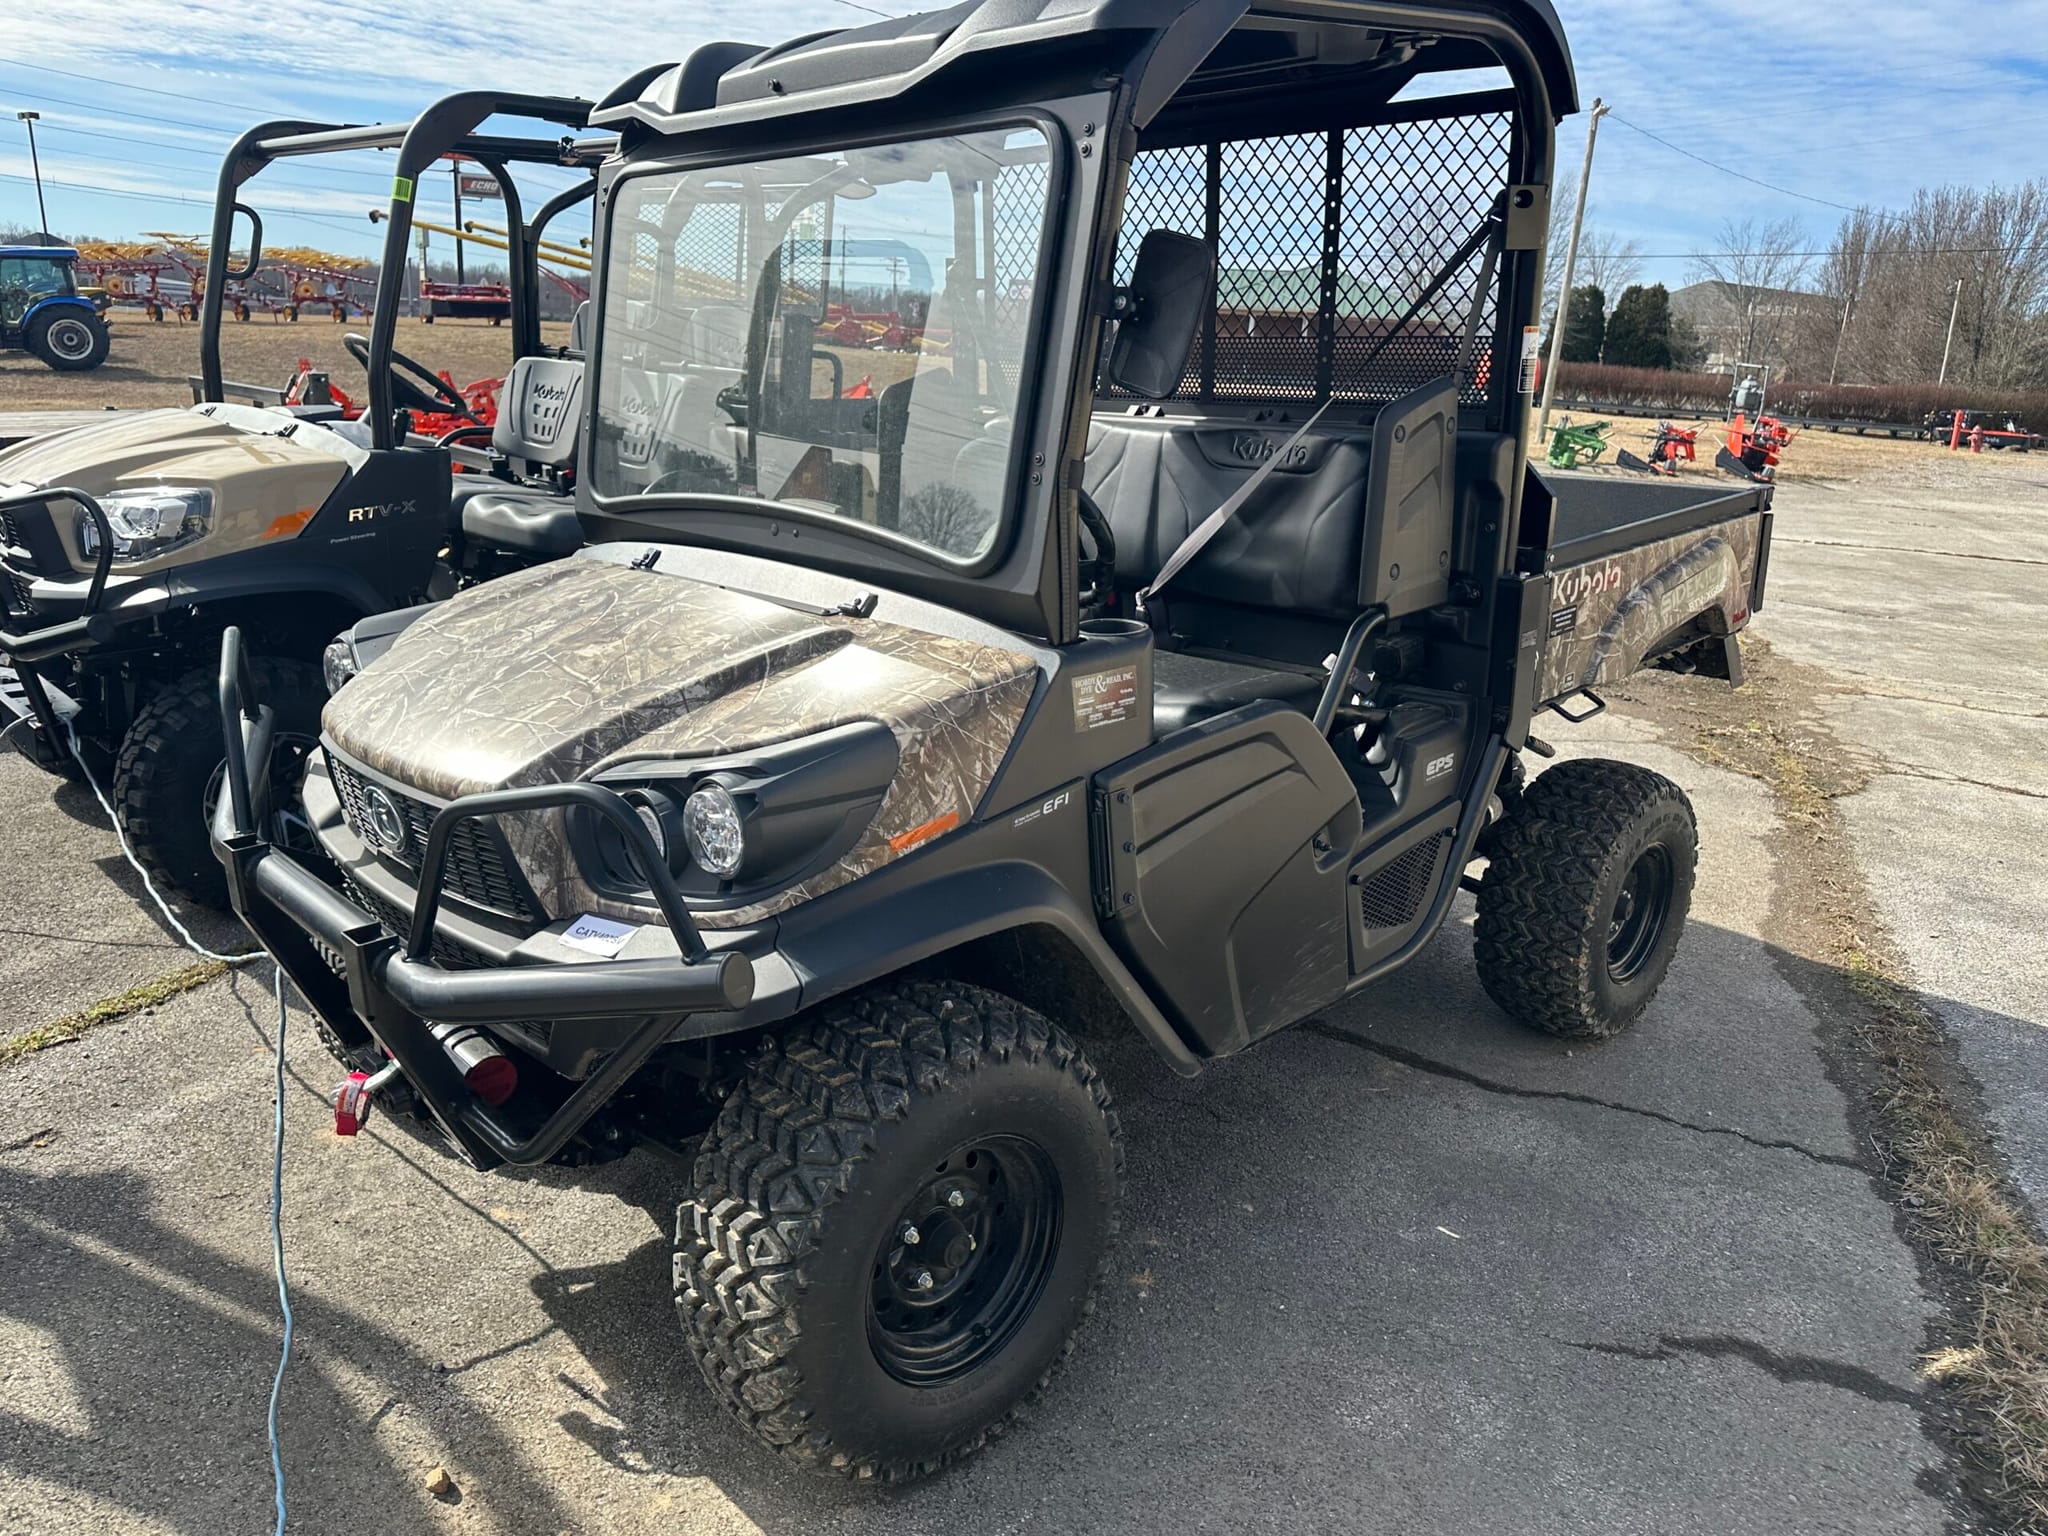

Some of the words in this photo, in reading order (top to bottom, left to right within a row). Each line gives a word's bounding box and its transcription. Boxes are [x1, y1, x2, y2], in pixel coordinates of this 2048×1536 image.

[470, 180, 500, 191] ECHO
[1232, 435, 1309, 466] Kubta
[348, 499, 417, 522] RTV-X
[1552, 560, 1621, 606] Kubota
[1426, 752, 1455, 776] EPS
[1042, 791, 1070, 815] EFI
